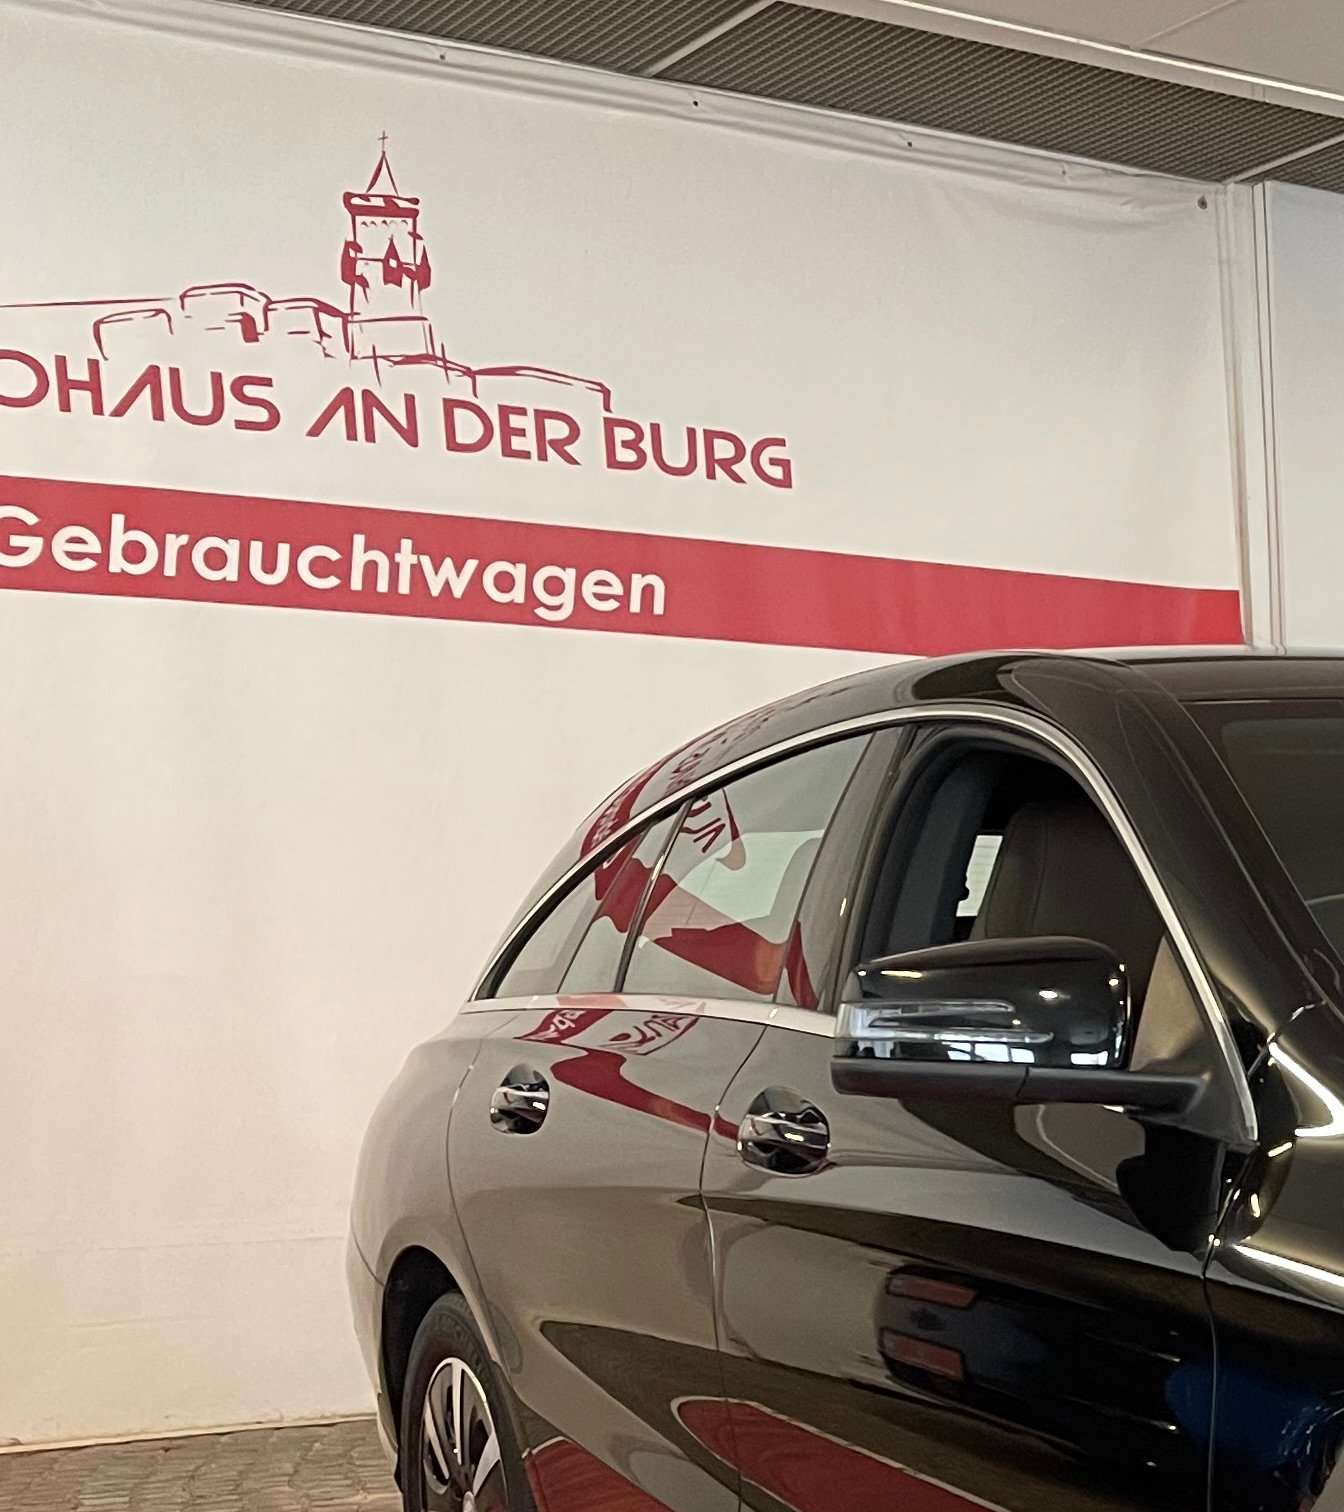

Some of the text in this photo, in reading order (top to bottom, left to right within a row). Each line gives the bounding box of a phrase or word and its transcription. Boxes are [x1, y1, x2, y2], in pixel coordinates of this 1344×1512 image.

[0, 348, 794, 490] OHAUS AN DER BURG
[0, 504, 666, 622] Gebrauchtwagen
